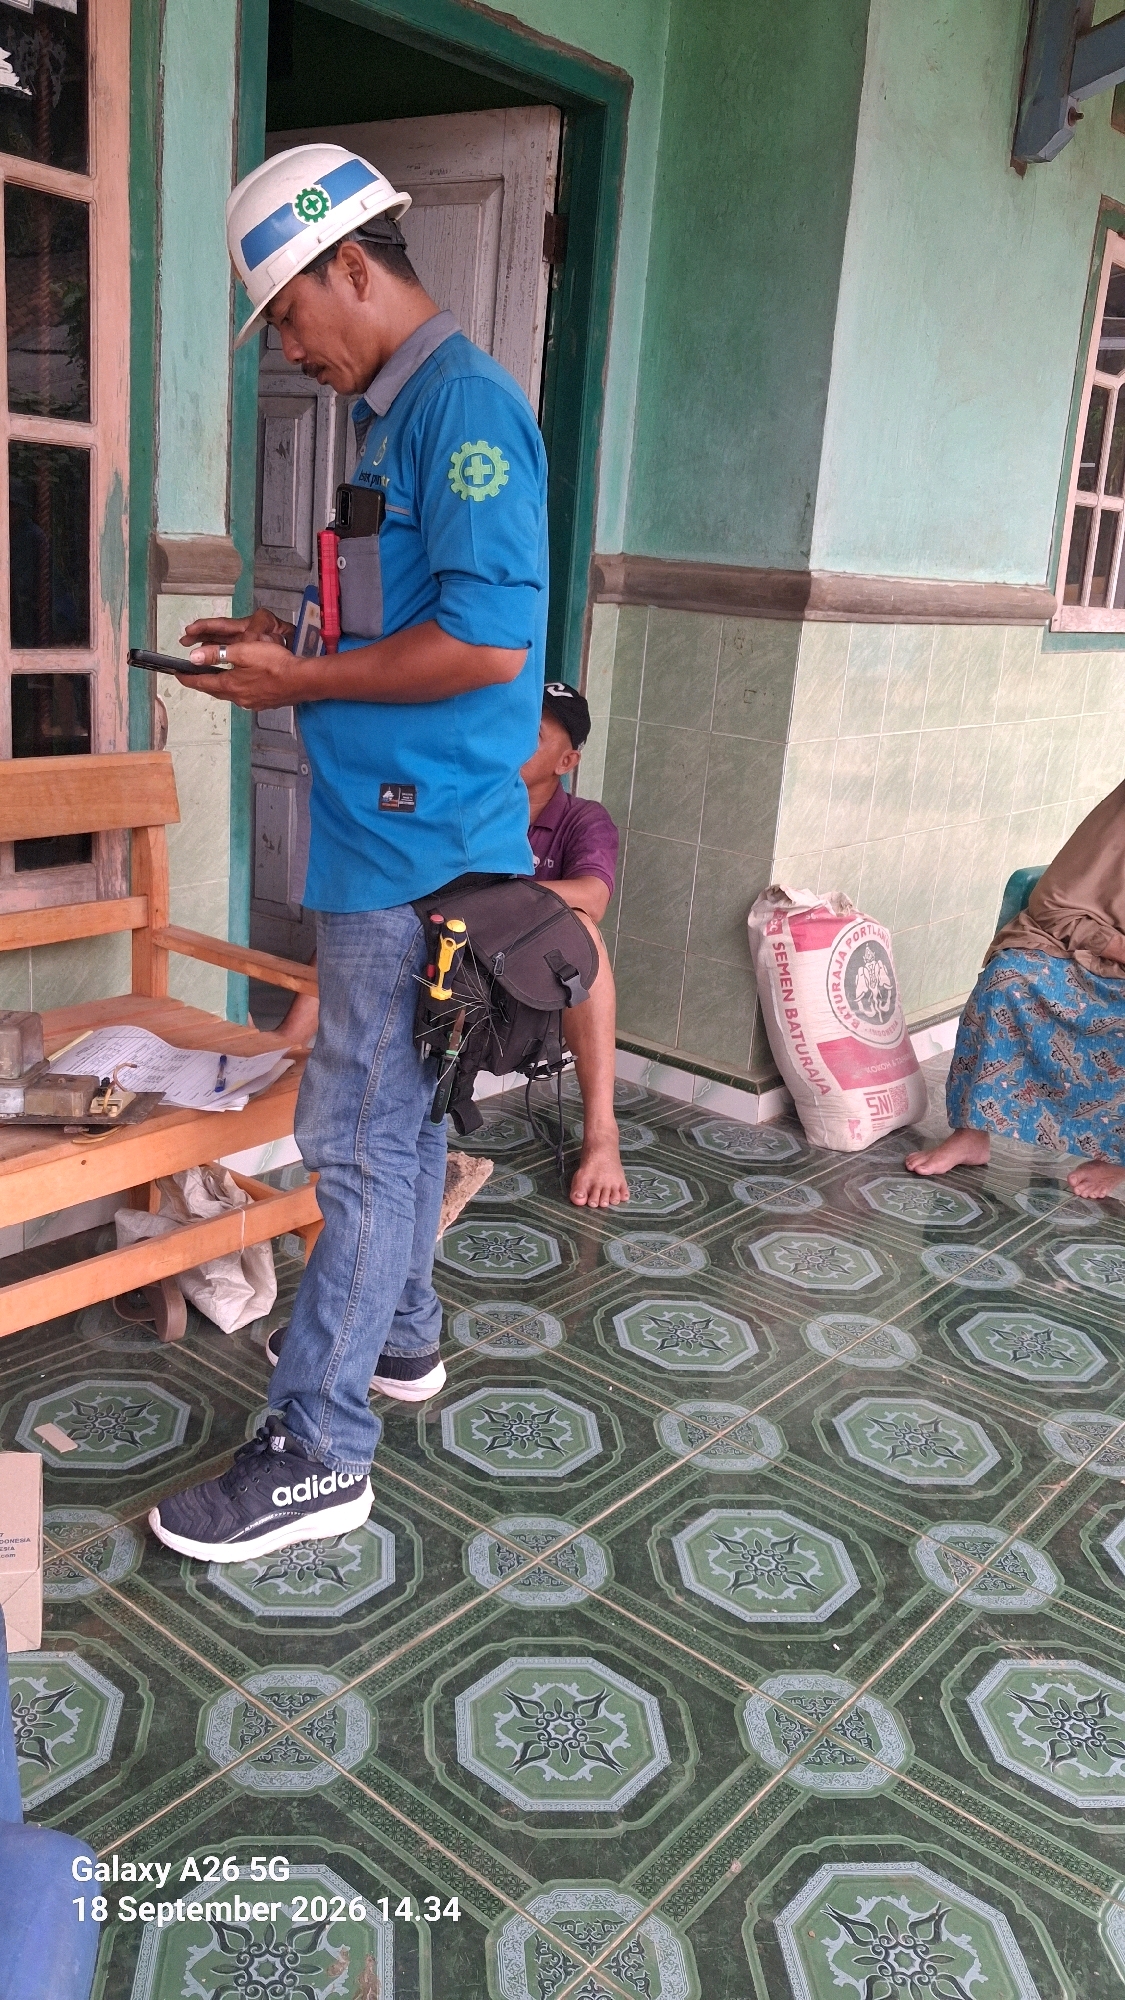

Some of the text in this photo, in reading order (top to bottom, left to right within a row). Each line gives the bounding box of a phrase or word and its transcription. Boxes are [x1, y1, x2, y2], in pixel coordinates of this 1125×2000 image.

[772, 941, 832, 1095] SEMEN BATURAJA
[831, 950, 860, 1030] BATURAJA
[866, 1094, 893, 1116] SNI
